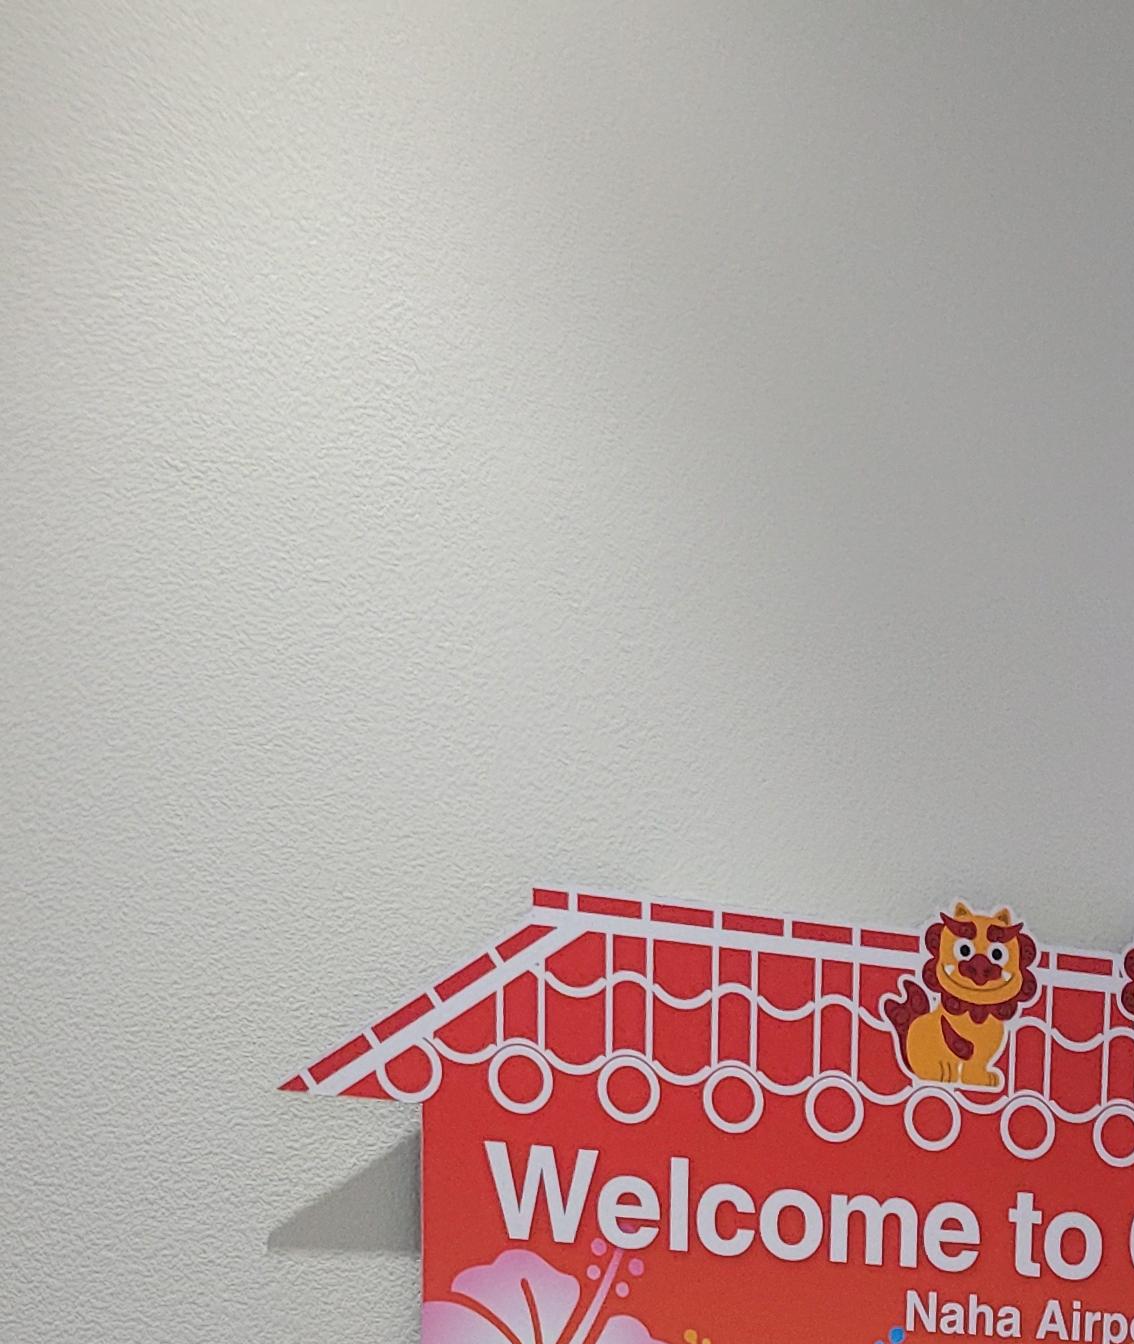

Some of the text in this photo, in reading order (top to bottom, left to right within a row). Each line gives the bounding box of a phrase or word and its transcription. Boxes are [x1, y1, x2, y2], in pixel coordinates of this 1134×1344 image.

[483, 1140, 981, 1273] Welcome
[1008, 1190, 1103, 1281] to
[905, 1289, 1022, 1339] Naha
